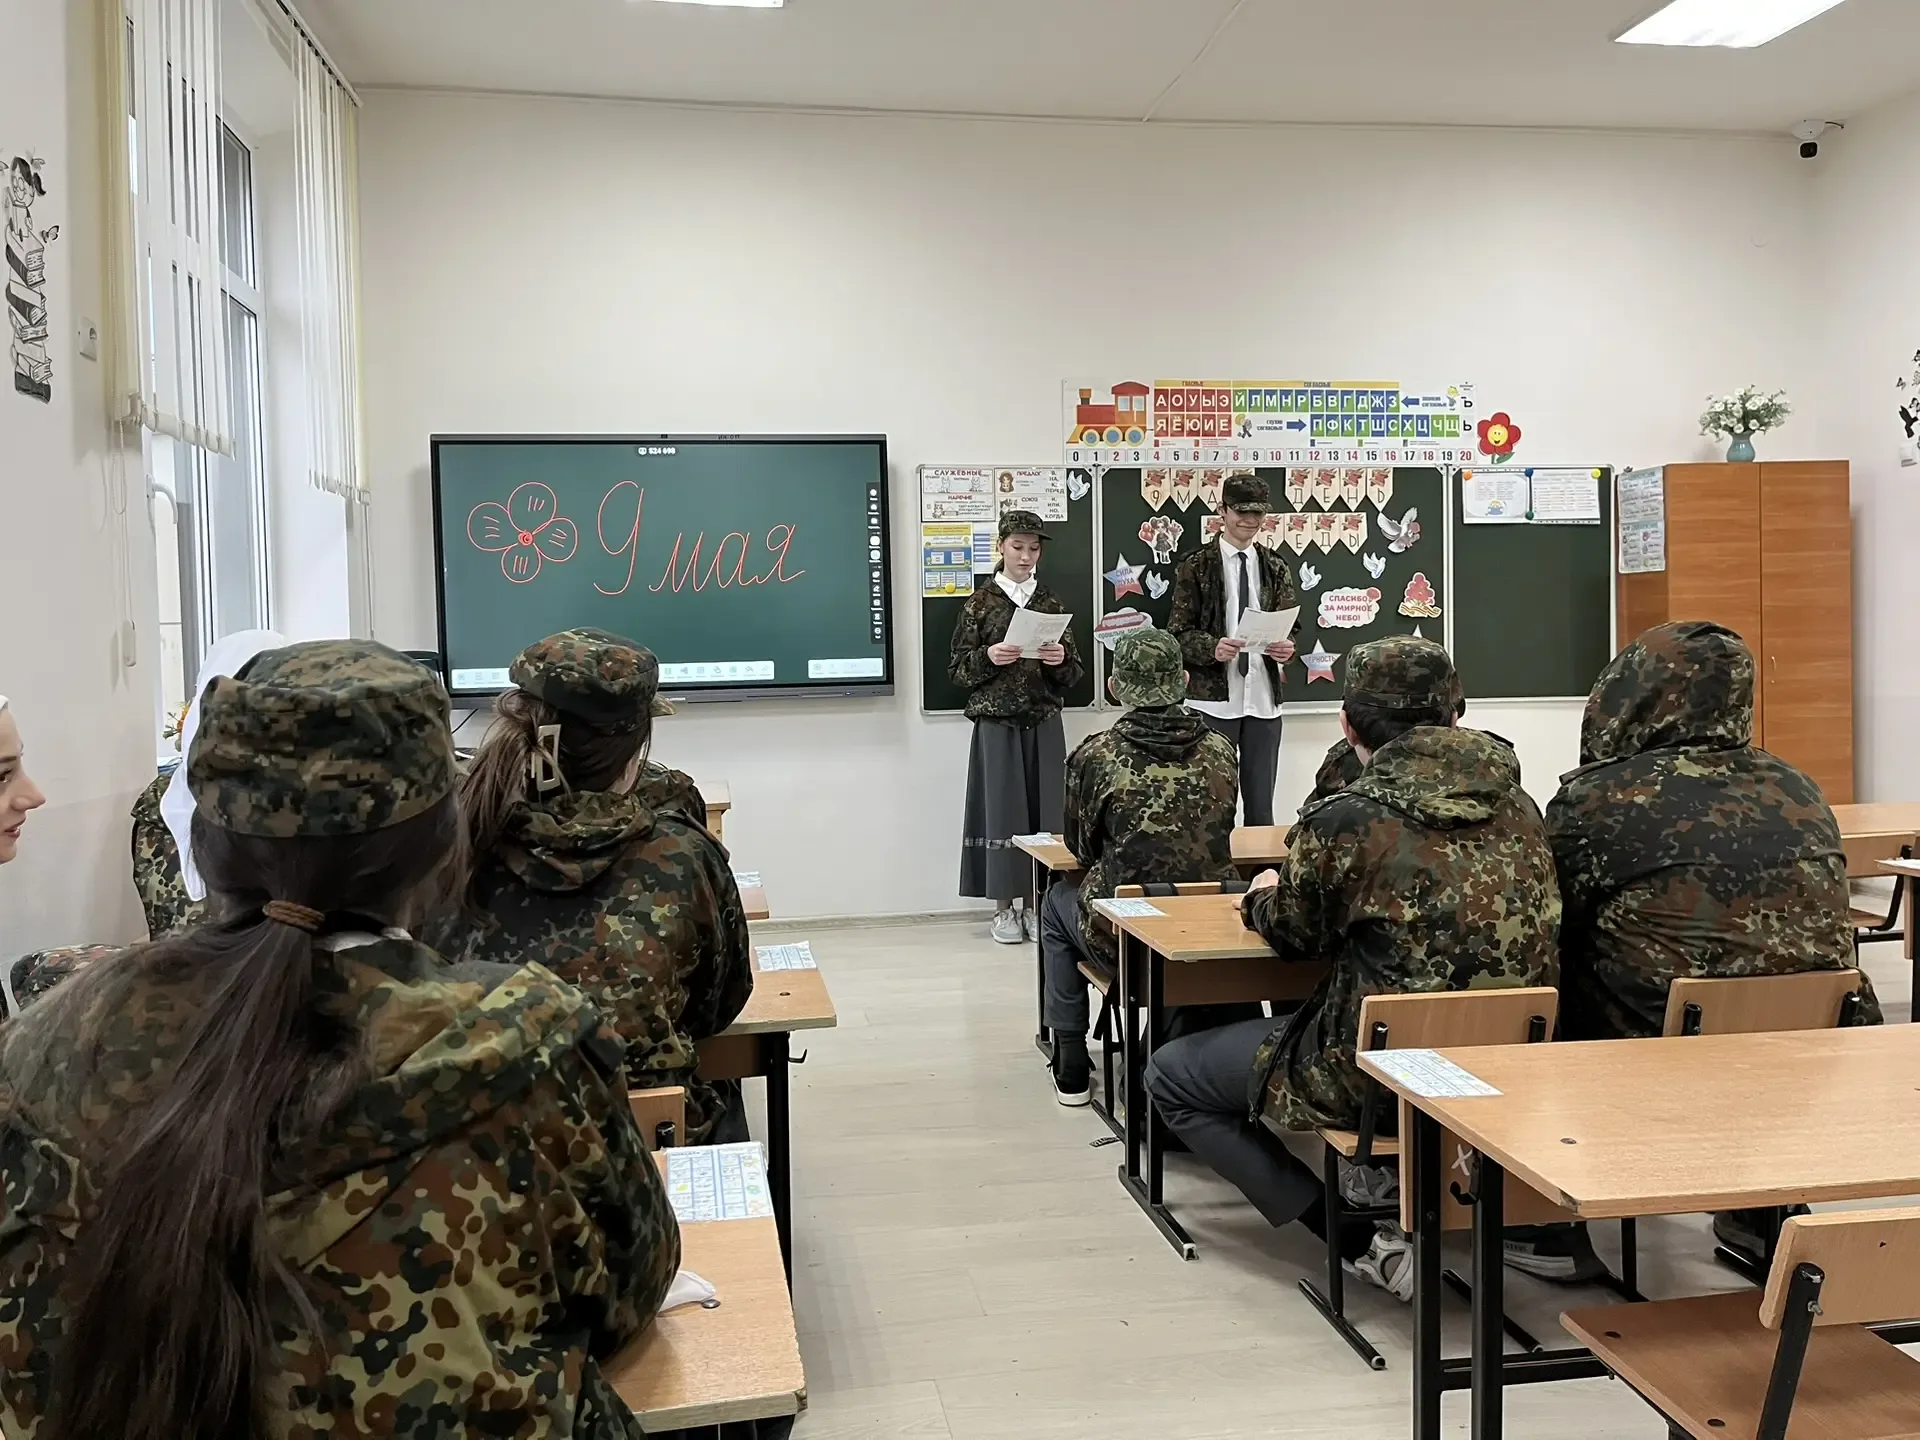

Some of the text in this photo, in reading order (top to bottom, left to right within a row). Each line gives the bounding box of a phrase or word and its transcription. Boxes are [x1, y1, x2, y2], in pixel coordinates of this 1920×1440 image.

[1156, 393, 1397, 409] А О У Ы Э Й Л М Н Р Б В Г Д Ж З
[1156, 416, 1229, 431] Я Ё Ю И Е
[1313, 419, 1473, 433] П Ф К Т Ш С Х Ц Ч Щ Ь
[1072, 450, 1472, 462] 0 1 2 3 4 5 6 7 8 9 10 11 12 13 14 15 16 17 18 19 20
[1152, 488, 1386, 505] 9 МА ДЕНЬ
[593, 480, 644, 595] 9
[648, 524, 806, 593] мая
[1116, 568, 1134, 577] СИЛА
[1324, 604, 1372, 612] ЗА МИРНОЕ
[1336, 614, 1360, 622] НЕБО!
